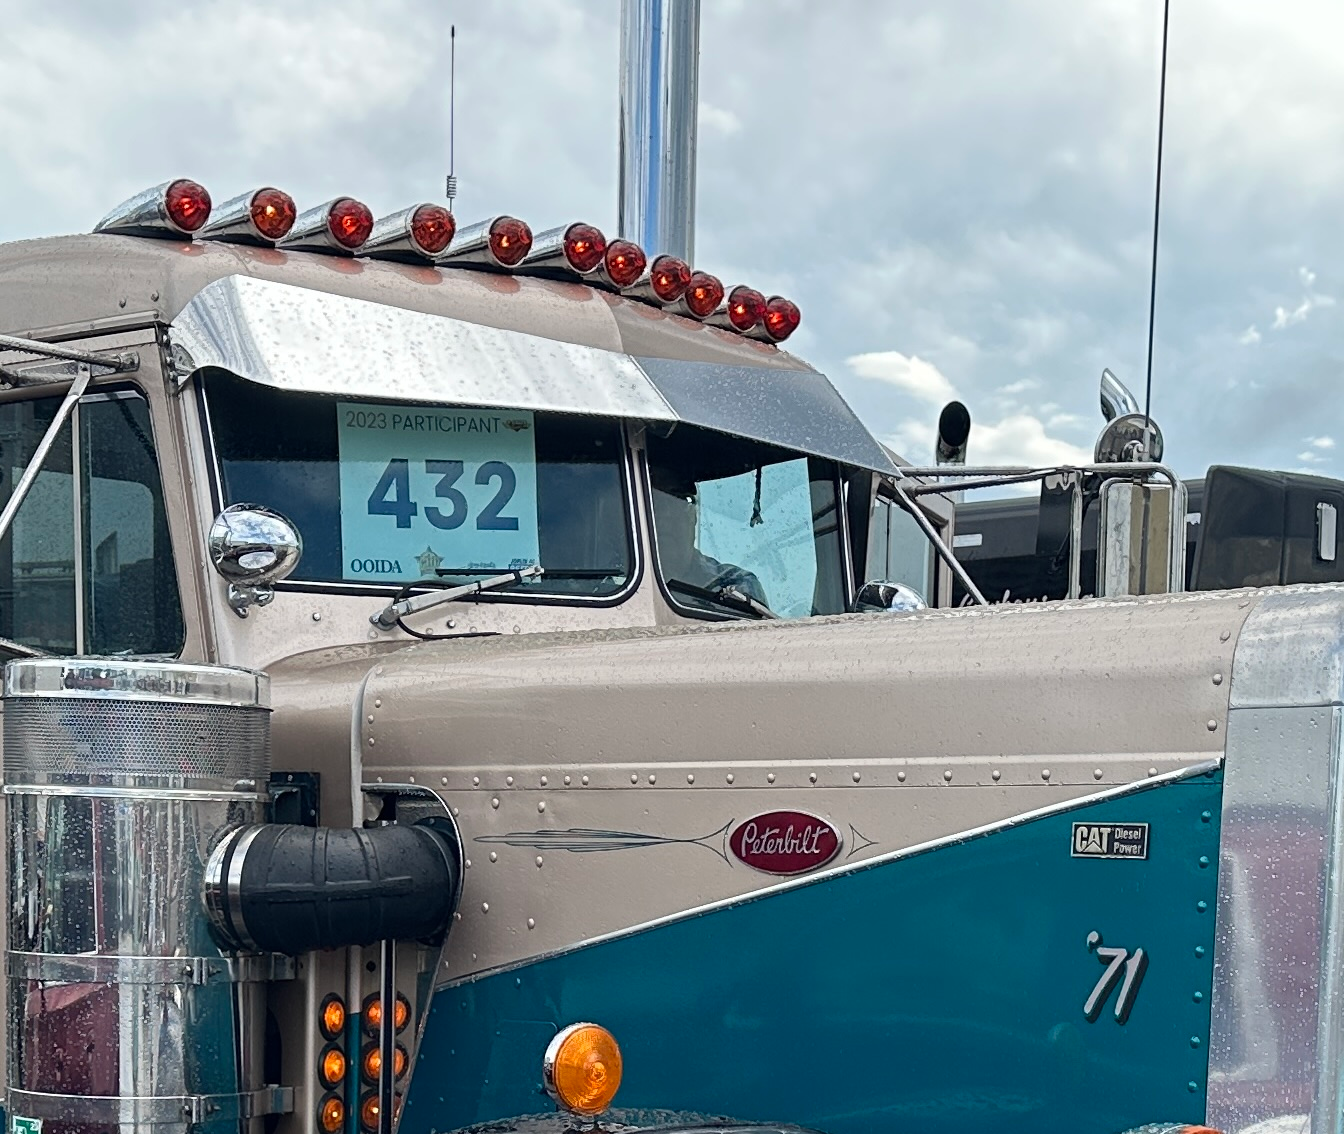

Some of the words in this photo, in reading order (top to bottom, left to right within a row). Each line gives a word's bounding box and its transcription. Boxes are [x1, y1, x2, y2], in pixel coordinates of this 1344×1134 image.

[346, 410, 387, 430] 2023
[392, 414, 501, 433] PARTICIPANT
[367, 457, 519, 531] 432
[350, 558, 403, 574] OOIDA
[741, 822, 830, 858] Peterbilt
[1076, 826, 1111, 854] CAT
[1114, 827, 1142, 840] Diesel
[1113, 841, 1142, 855] Power
